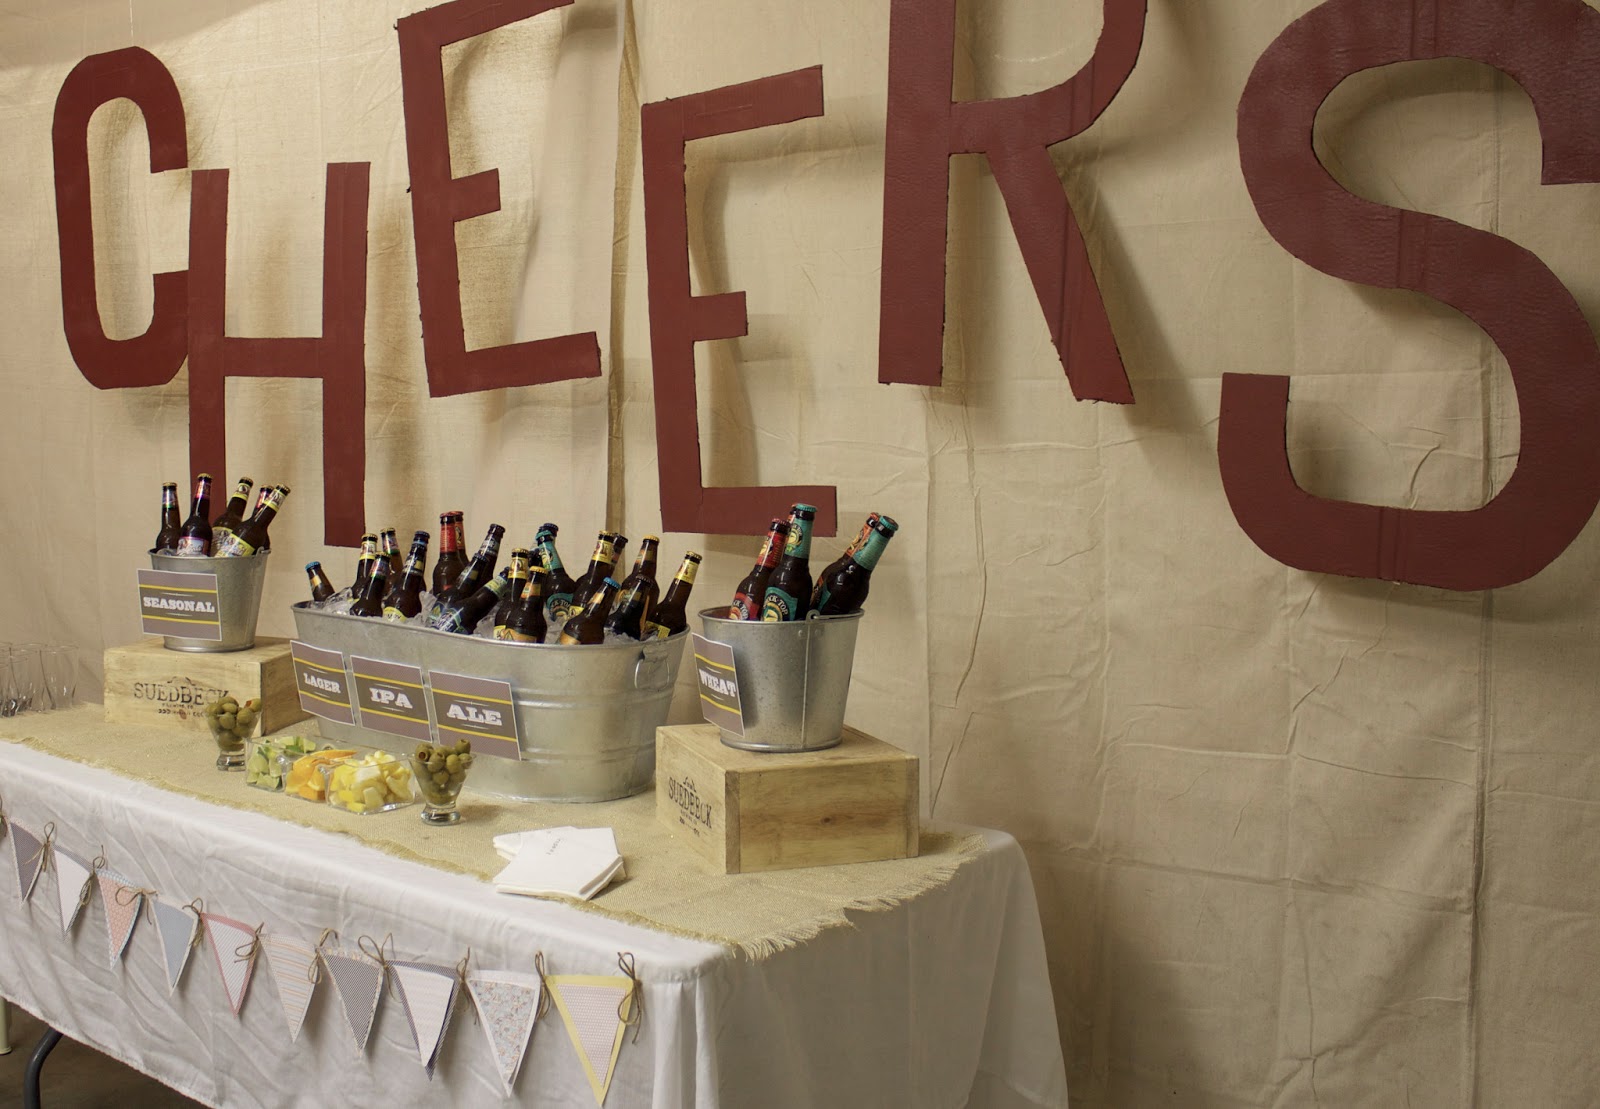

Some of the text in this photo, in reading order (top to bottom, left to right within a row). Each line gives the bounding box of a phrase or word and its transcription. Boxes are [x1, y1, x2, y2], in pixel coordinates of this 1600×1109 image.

[52, 0, 1600, 590] CHEERS
[143, 598, 215, 613] SEASONAL
[304, 673, 341, 693] LAGER
[698, 668, 736, 698] WHEAT
[369, 687, 413, 709] IPA
[446, 703, 503, 726] ALE
